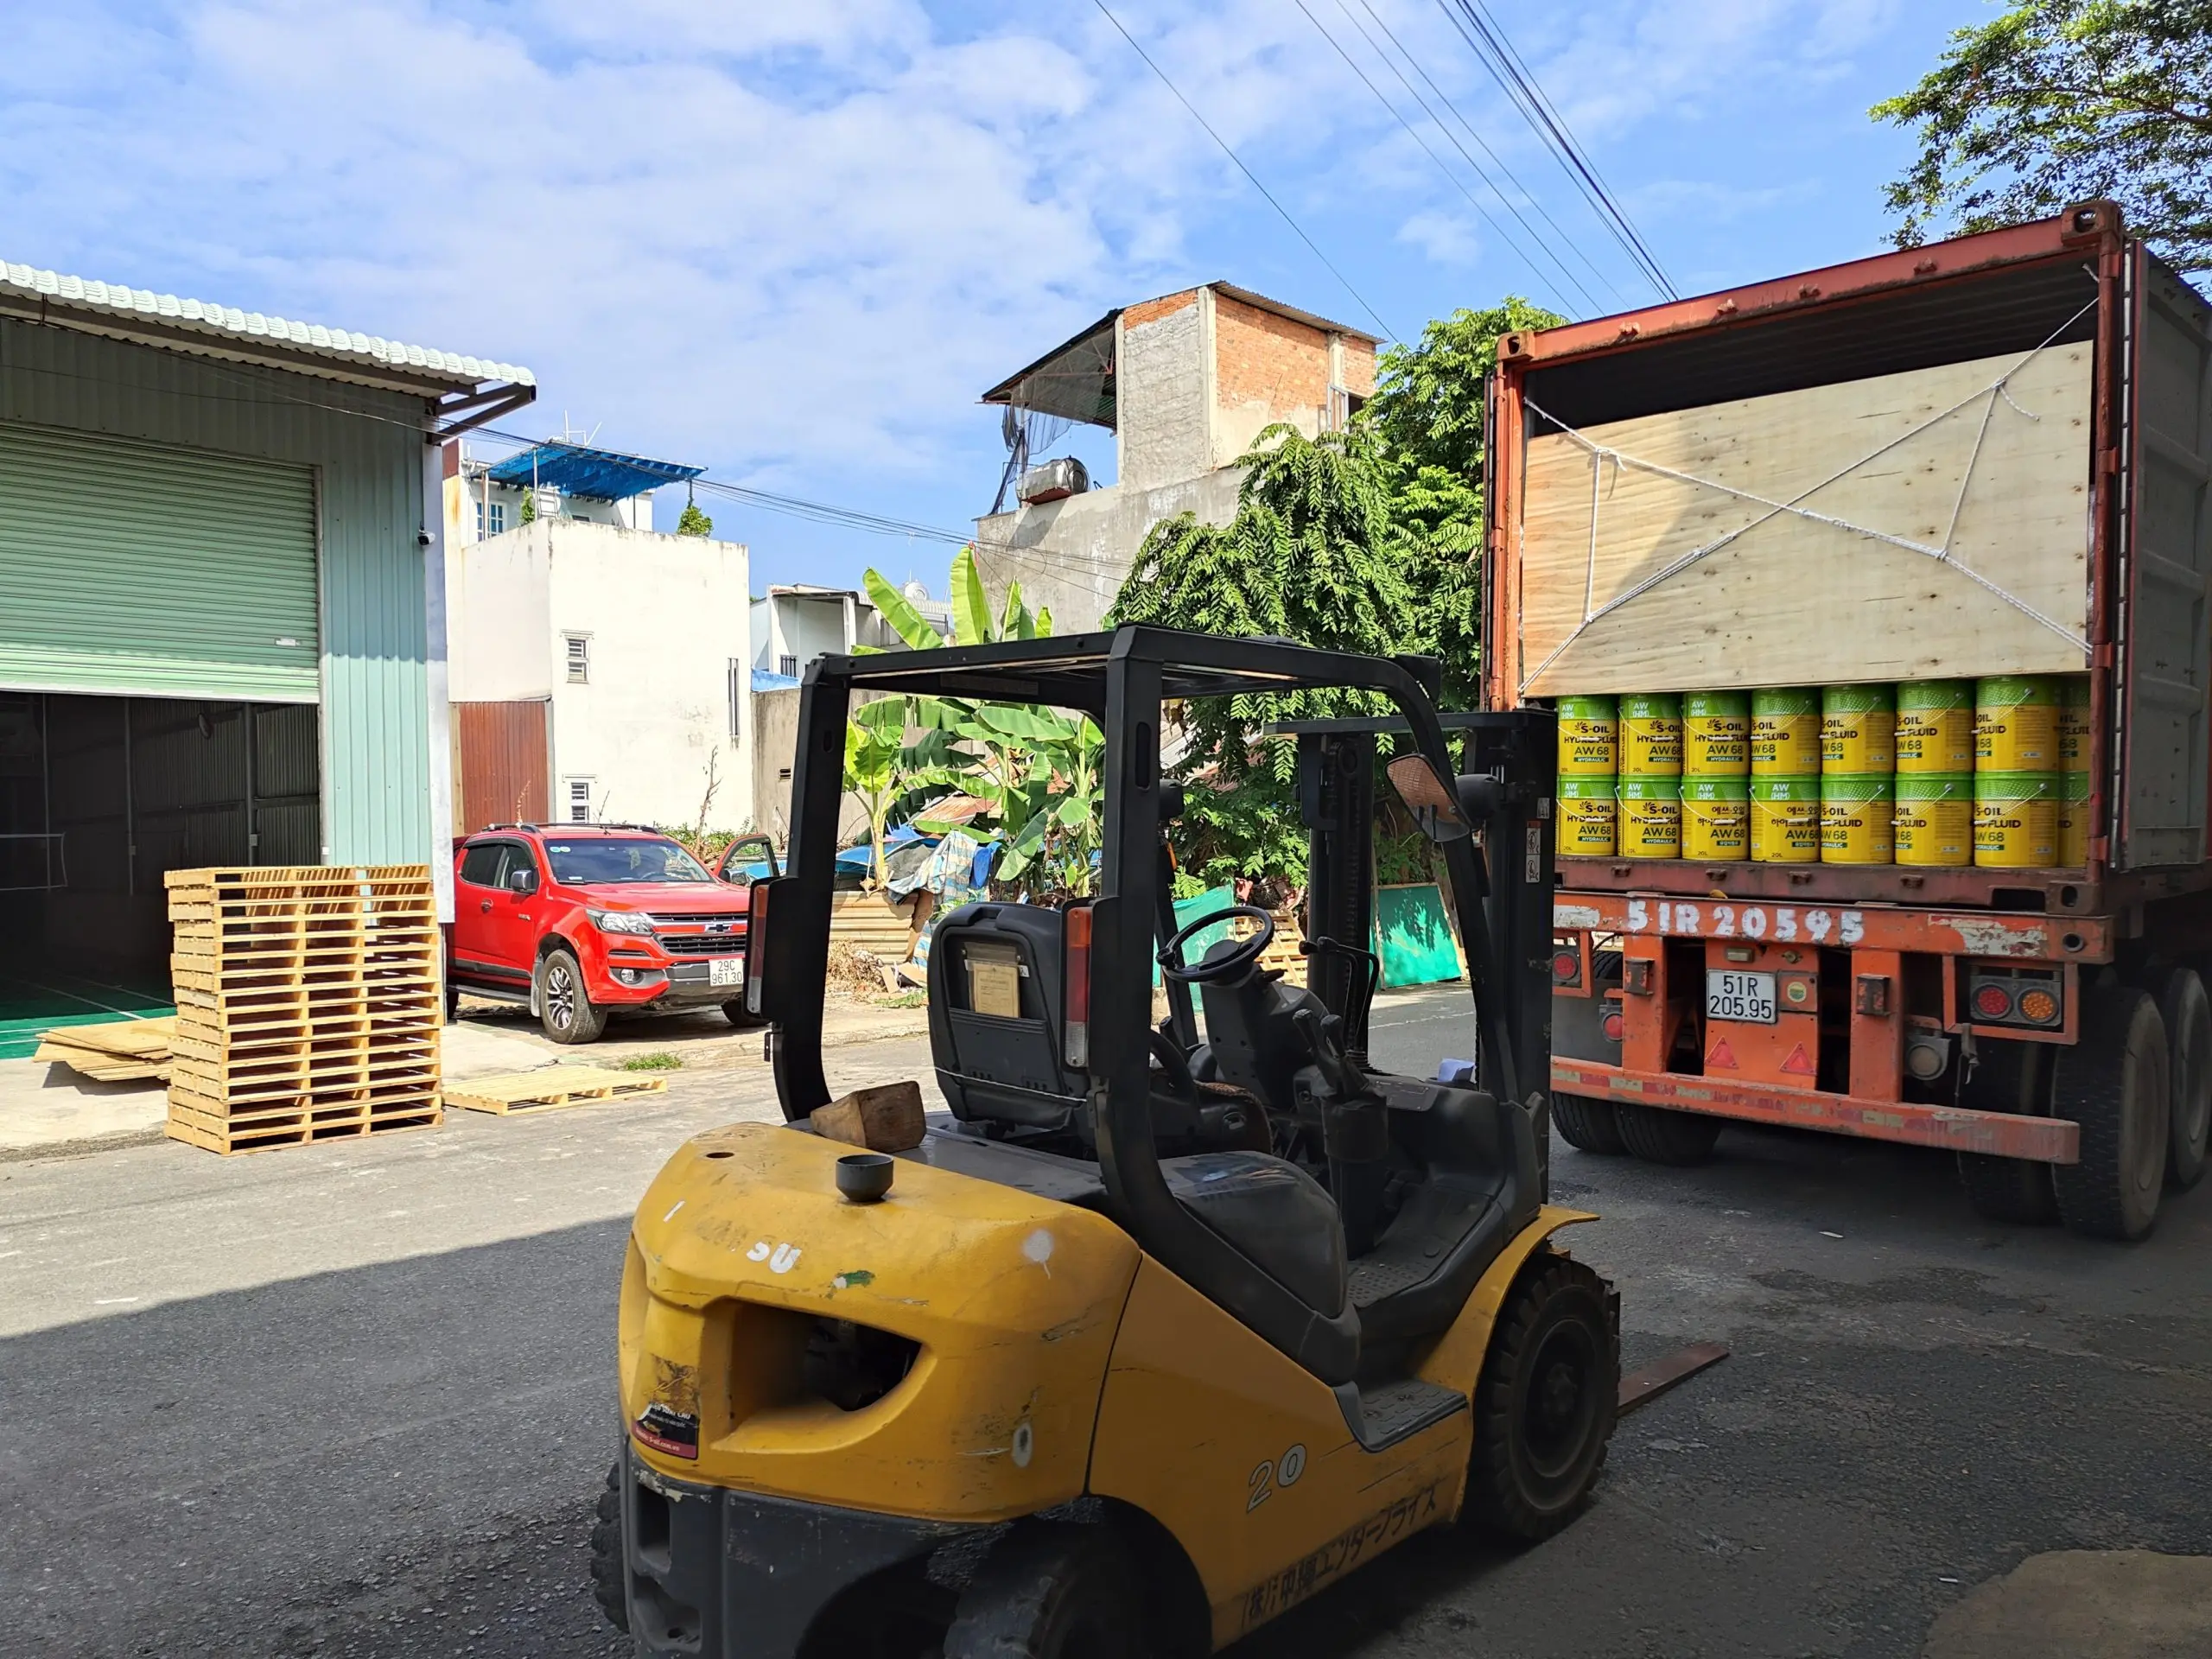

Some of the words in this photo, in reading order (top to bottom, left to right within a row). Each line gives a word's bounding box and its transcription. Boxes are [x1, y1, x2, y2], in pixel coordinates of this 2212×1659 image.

[1692, 700, 1706, 709] AW
[1656, 724, 1682, 733] S-OIL
[1713, 722, 1744, 731] S-OIL
[1831, 742, 1843, 752] 68
[1907, 740, 1922, 750] 68
[1980, 738, 1992, 748] 68
[1574, 747, 1595, 755] AW
[1597, 747, 1610, 755] 68
[1649, 746, 1670, 755] AW
[1671, 746, 1681, 755] 68
[1707, 745, 1729, 753] AW
[1731, 745, 1743, 753] 68
[1762, 744, 1776, 753] 68
[1770, 791, 1790, 800] (HM)
[1585, 804, 1612, 813] S-OIL
[1649, 805, 1678, 814] S-OIL
[1579, 826, 1599, 835] AW
[1600, 826, 1611, 835] 68
[1642, 827, 1663, 836] AW
[1665, 827, 1676, 836] 68
[1710, 829, 1732, 838] AW
[1733, 829, 1745, 838] 68
[1785, 830, 1808, 839] AW
[1833, 830, 1847, 840] 68
[1901, 831, 1912, 841] 68
[1988, 832, 2005, 842] 68
[1628, 900, 1700, 934] 51R
[1713, 906, 1865, 943] 20595
[717, 960, 735, 971] 29C
[711, 971, 742, 984] 961.30
[1723, 975, 1759, 996] 51R
[1709, 995, 1772, 1020] 205.95
[1246, 1443, 1307, 1514] 20
